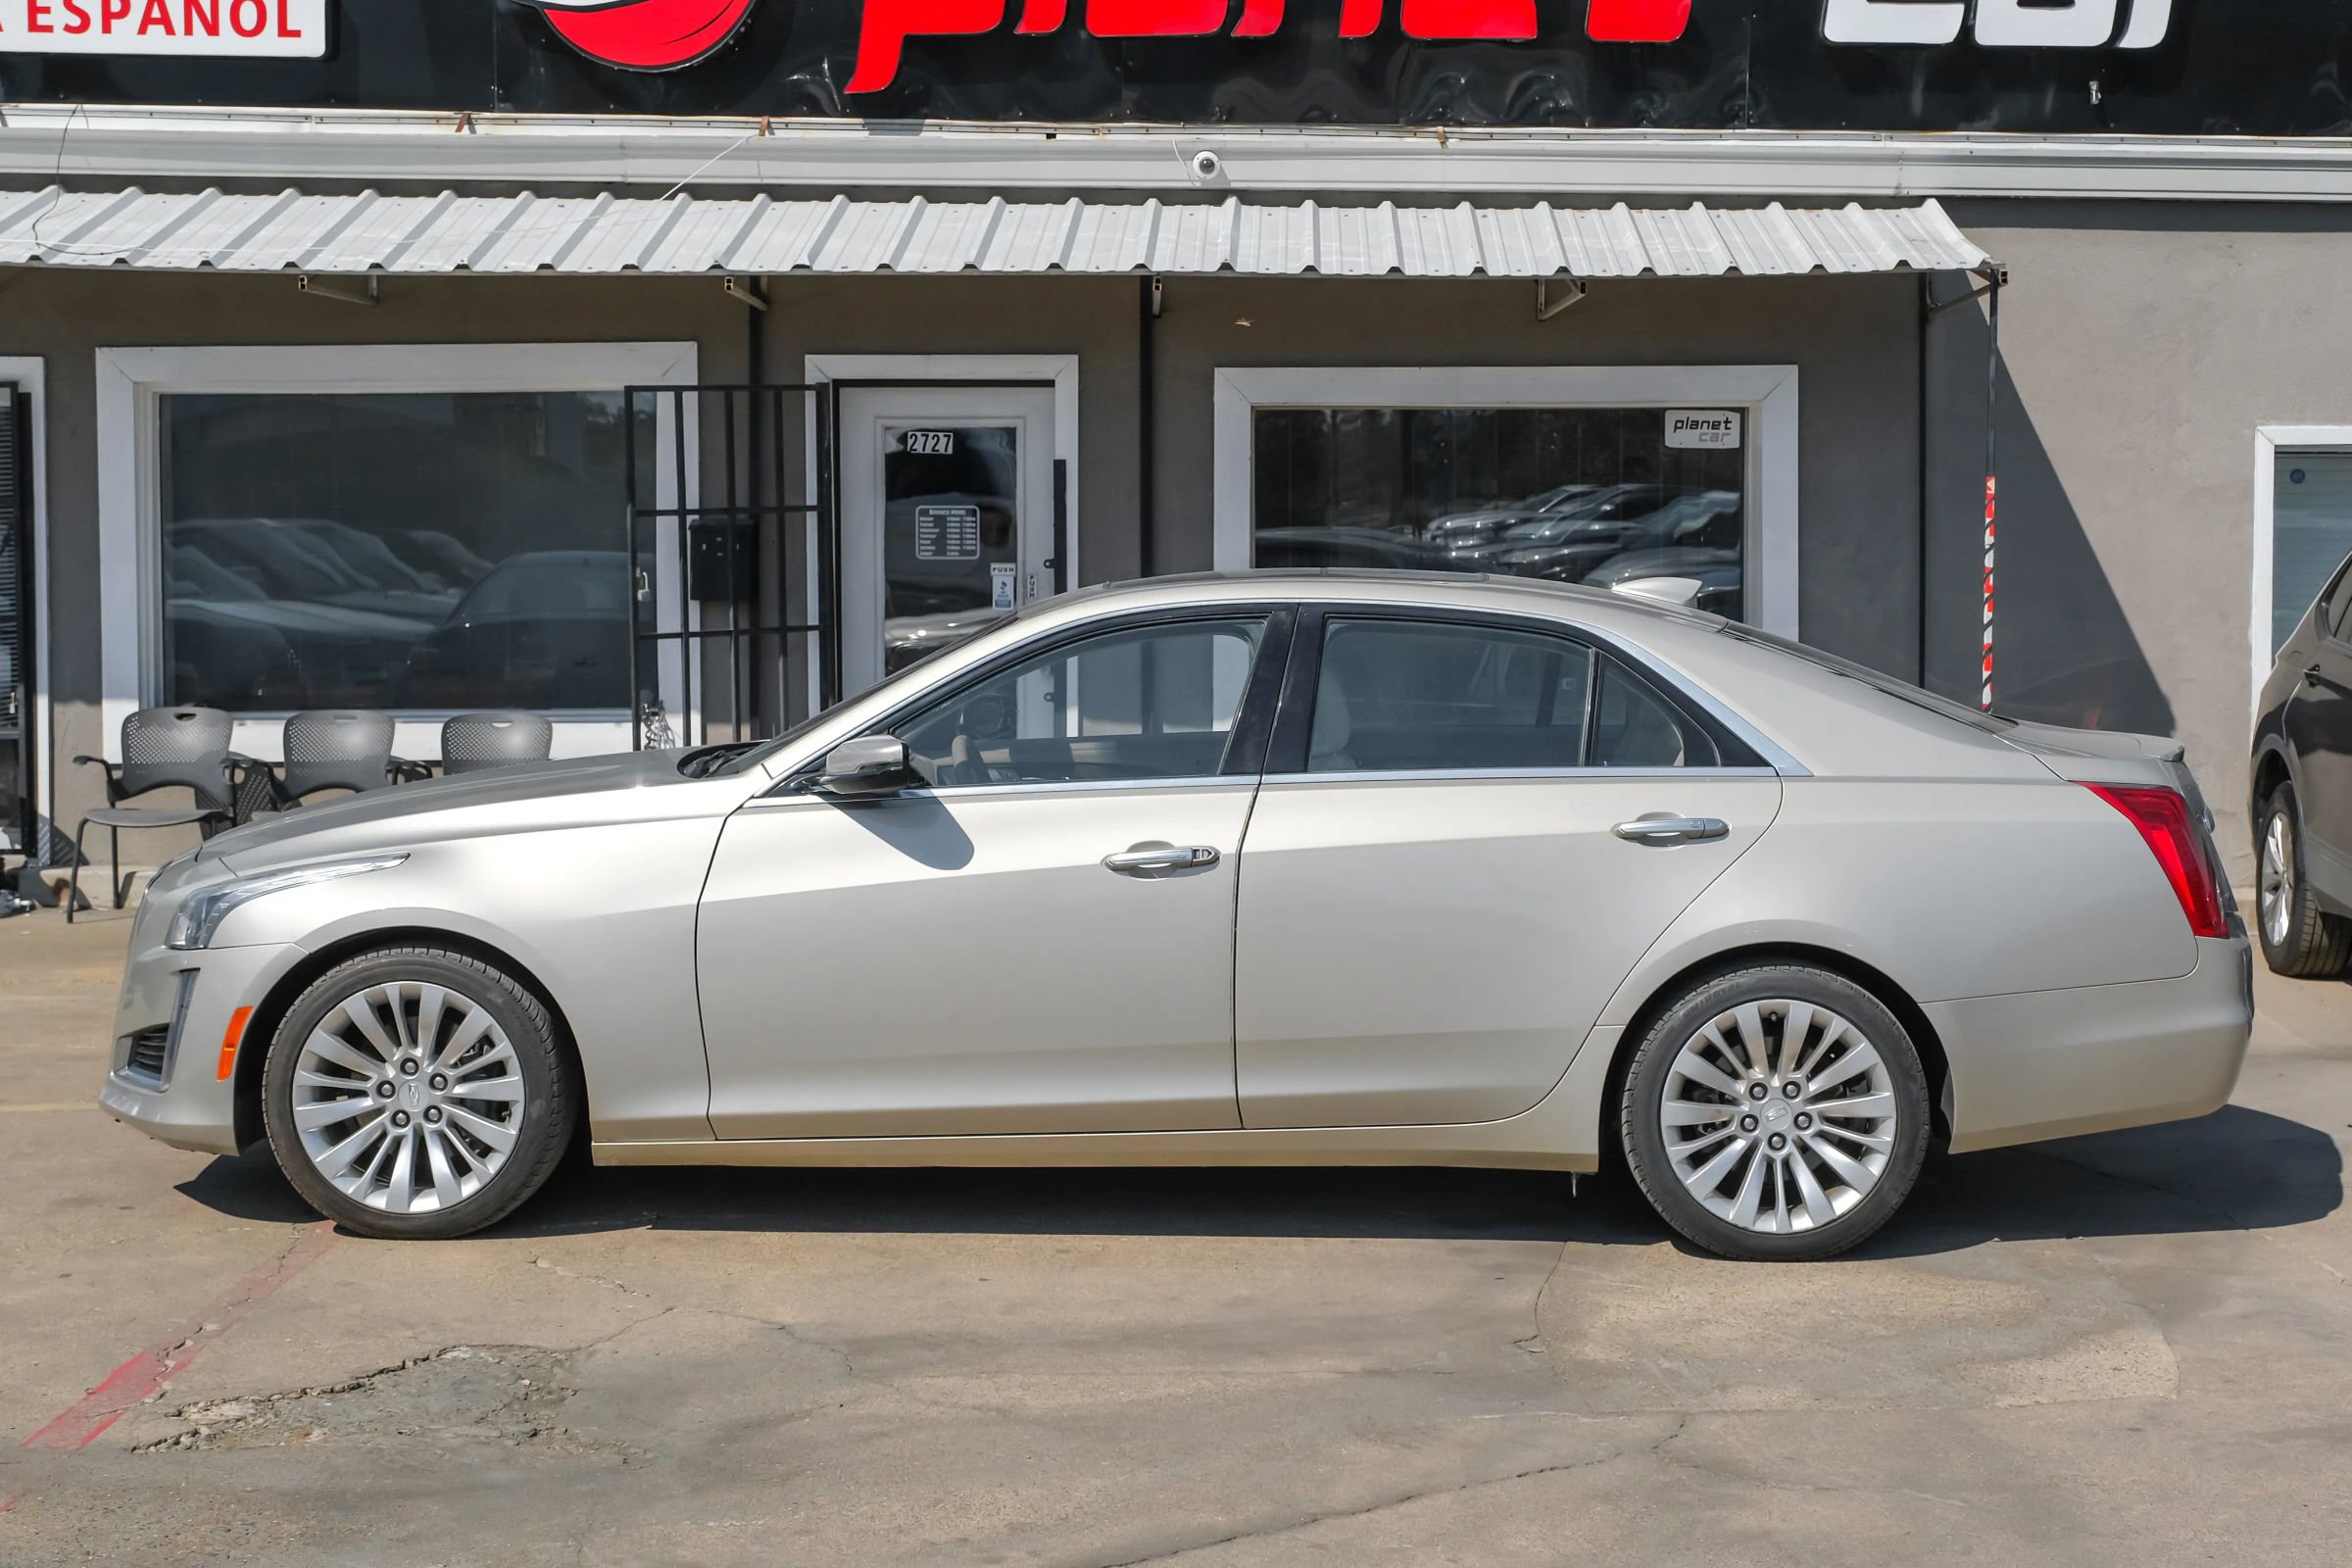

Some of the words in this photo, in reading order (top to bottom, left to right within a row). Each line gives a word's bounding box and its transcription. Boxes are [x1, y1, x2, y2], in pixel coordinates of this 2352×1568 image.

[1673, 416, 1733, 433] planet
[908, 432, 953, 453] 2727
[1698, 432, 1732, 442] car
